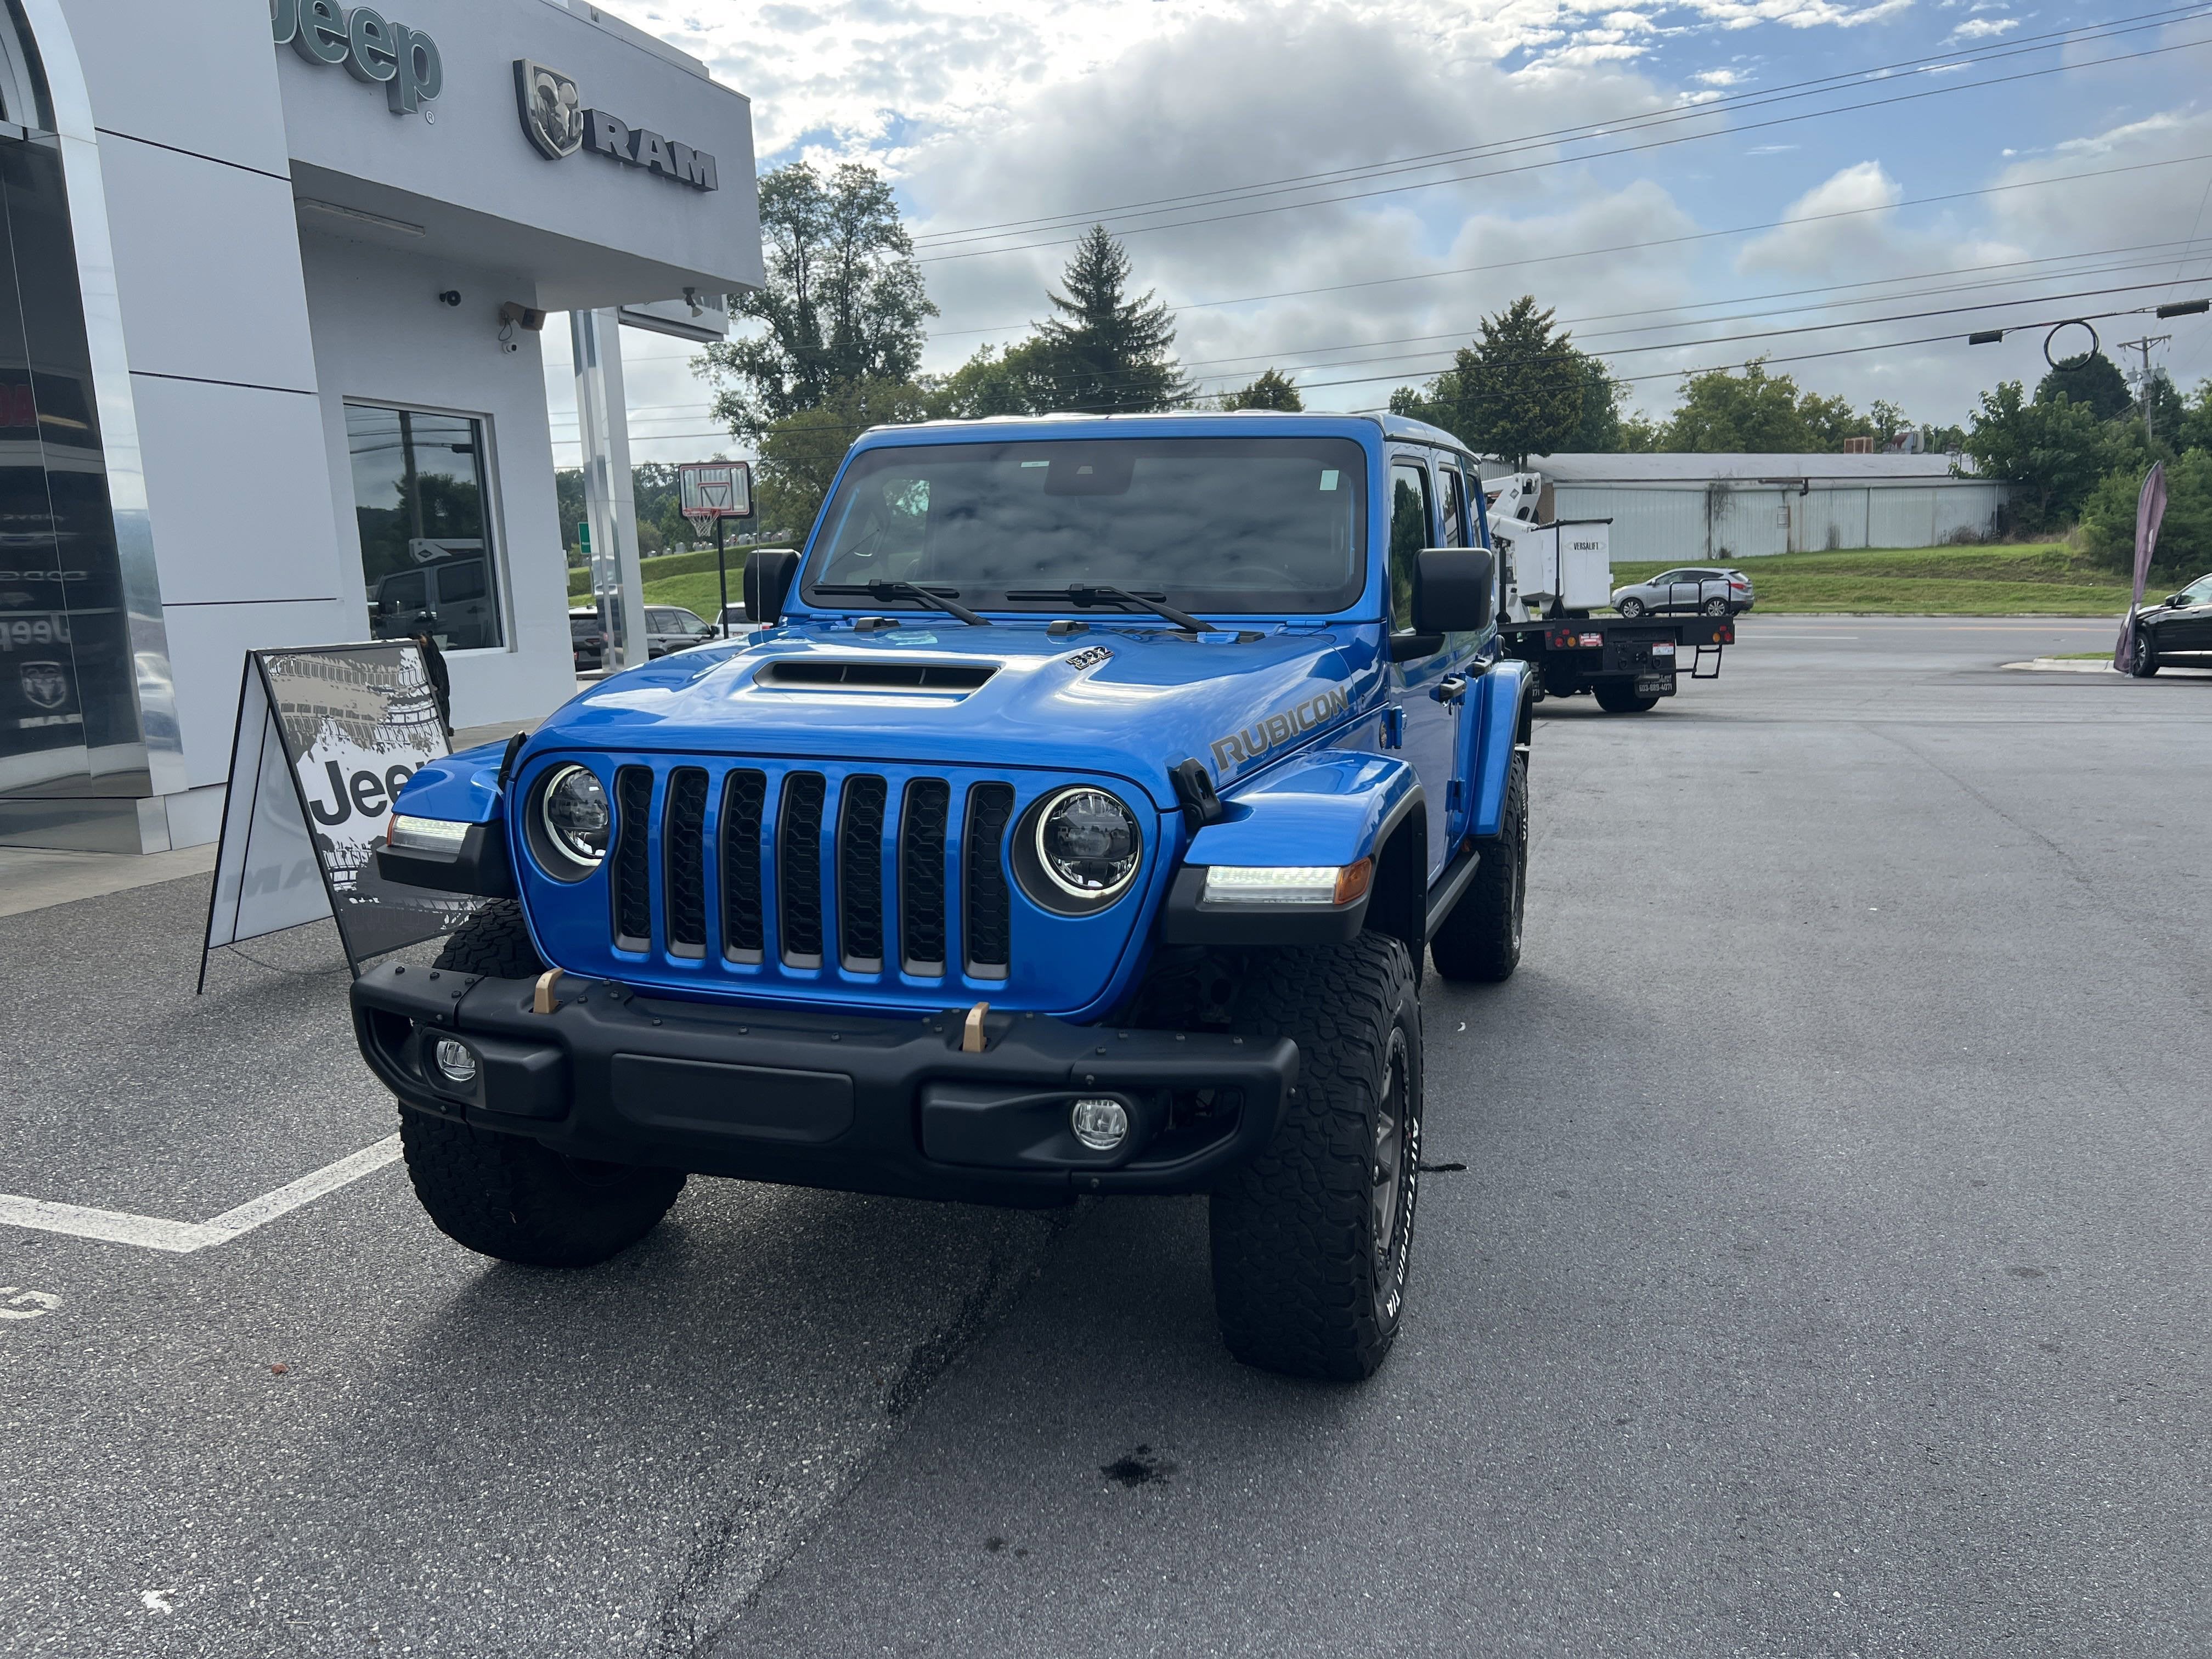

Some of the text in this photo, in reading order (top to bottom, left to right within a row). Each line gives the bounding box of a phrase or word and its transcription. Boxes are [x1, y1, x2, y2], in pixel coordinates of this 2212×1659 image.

[583, 109, 718, 191] RAM
[1573, 541, 1599, 550] VERSALIFT
[1065, 645, 1115, 671] 392
[1210, 685, 1350, 771] RUBICON
[309, 759, 437, 826] Jee
[1386, 1116, 1419, 1318] All-Terrain T/A
